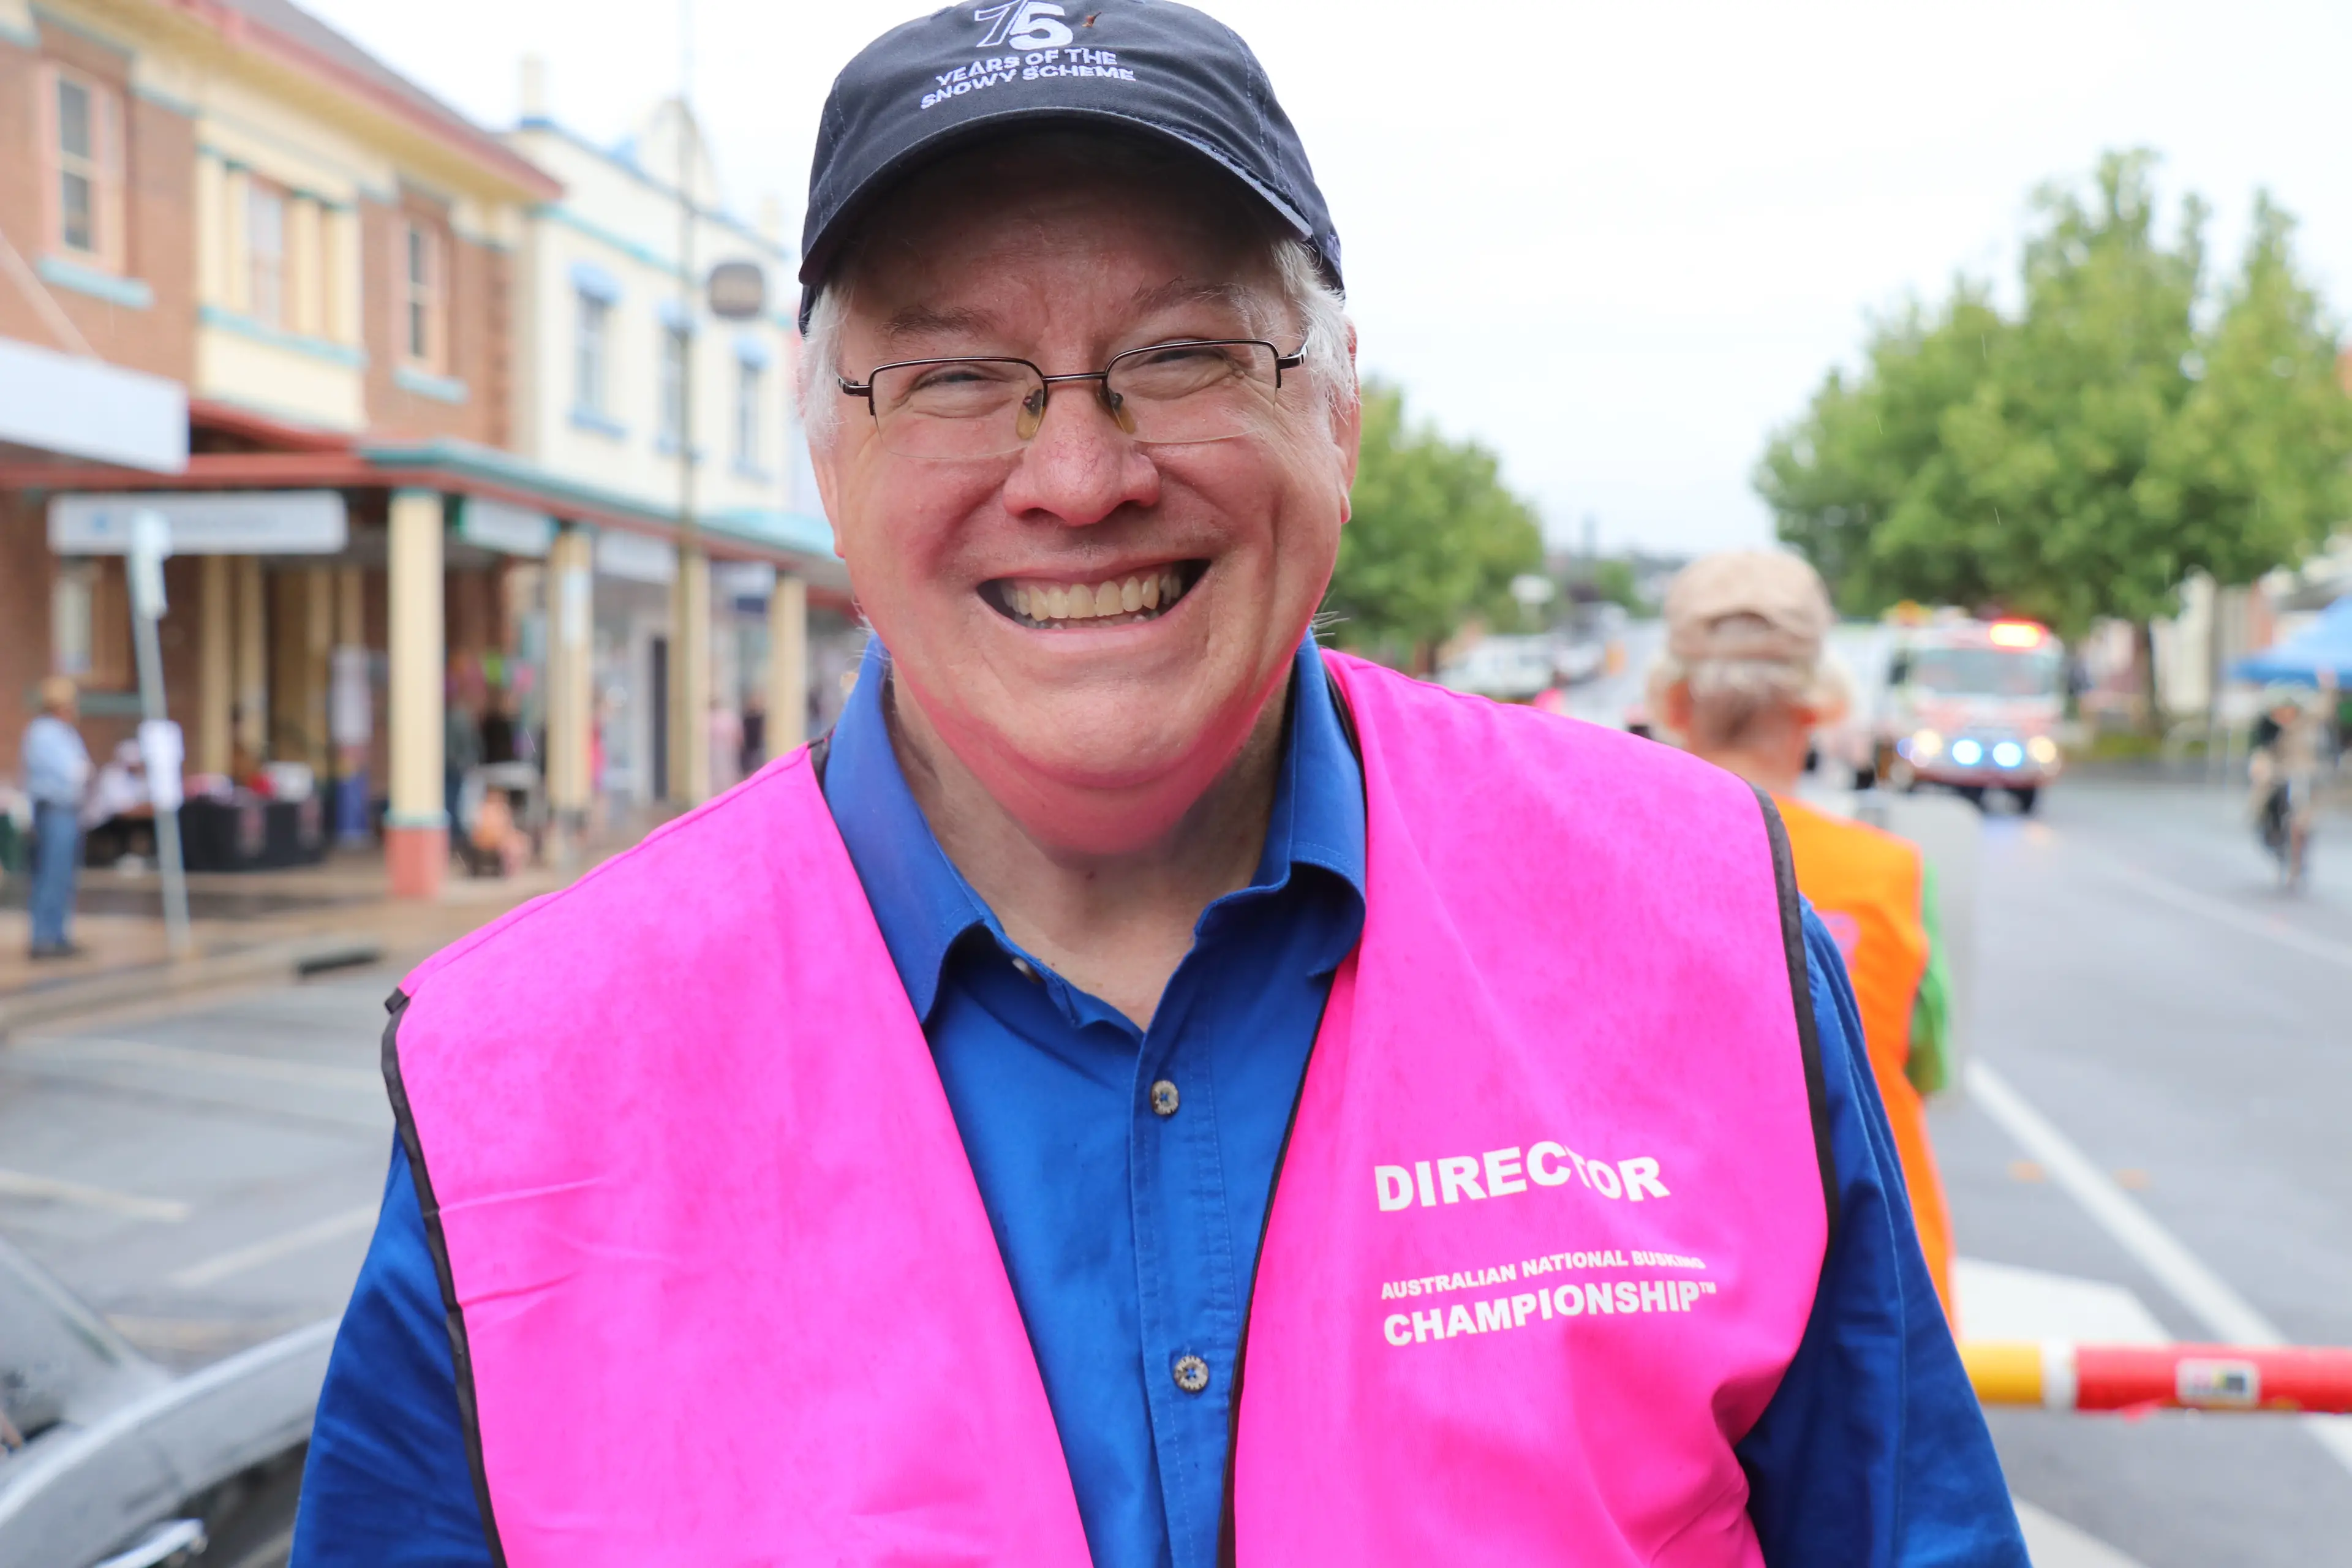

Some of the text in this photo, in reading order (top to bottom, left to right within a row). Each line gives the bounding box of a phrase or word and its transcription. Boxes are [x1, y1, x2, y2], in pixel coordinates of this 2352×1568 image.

[974, 0, 1074, 51] 75
[920, 64, 1136, 110] SNOWY SCHEME
[935, 48, 1118, 87] YEARS OF THE
[1374, 1140, 1671, 1212] DIRECTOR
[1381, 1264, 1517, 1300] AUSTRALIAN
[1522, 1250, 1629, 1278] NATIONAL
